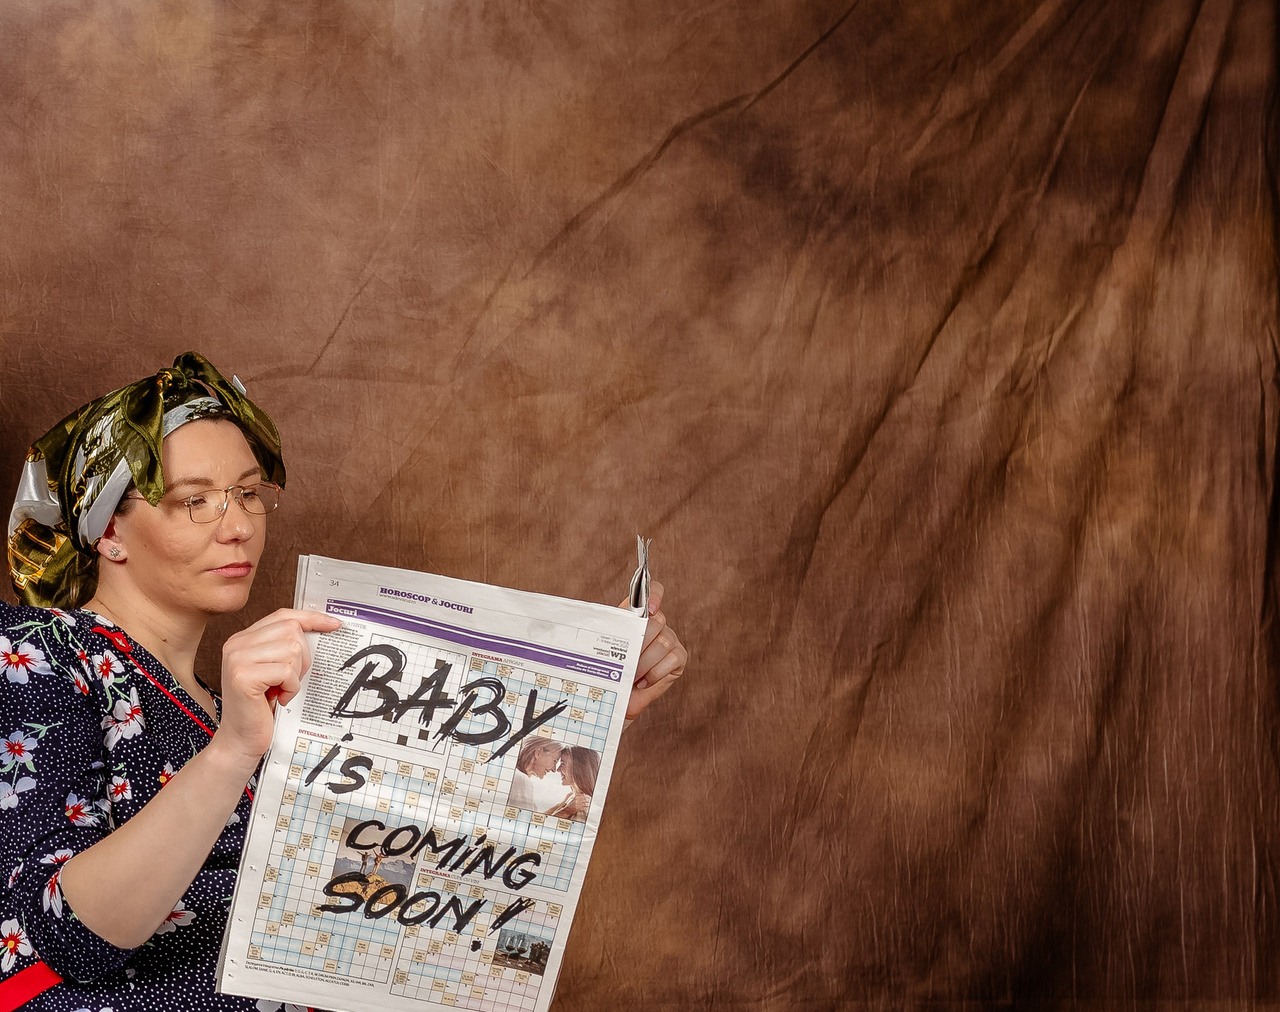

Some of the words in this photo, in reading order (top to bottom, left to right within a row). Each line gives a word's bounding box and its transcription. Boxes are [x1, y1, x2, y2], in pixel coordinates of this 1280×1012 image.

[329, 579, 339, 587] 34
[380, 587, 431, 603] HOROSCOP
[439, 600, 474, 614] JOCURI
[328, 605, 358, 616] Jocuri
[472, 652, 503, 662] INTEGRAMA
[330, 644, 567, 764] BABY
[299, 729, 328, 739] INTEGRAMA
[420, 868, 450, 878] INTEGRAMA
